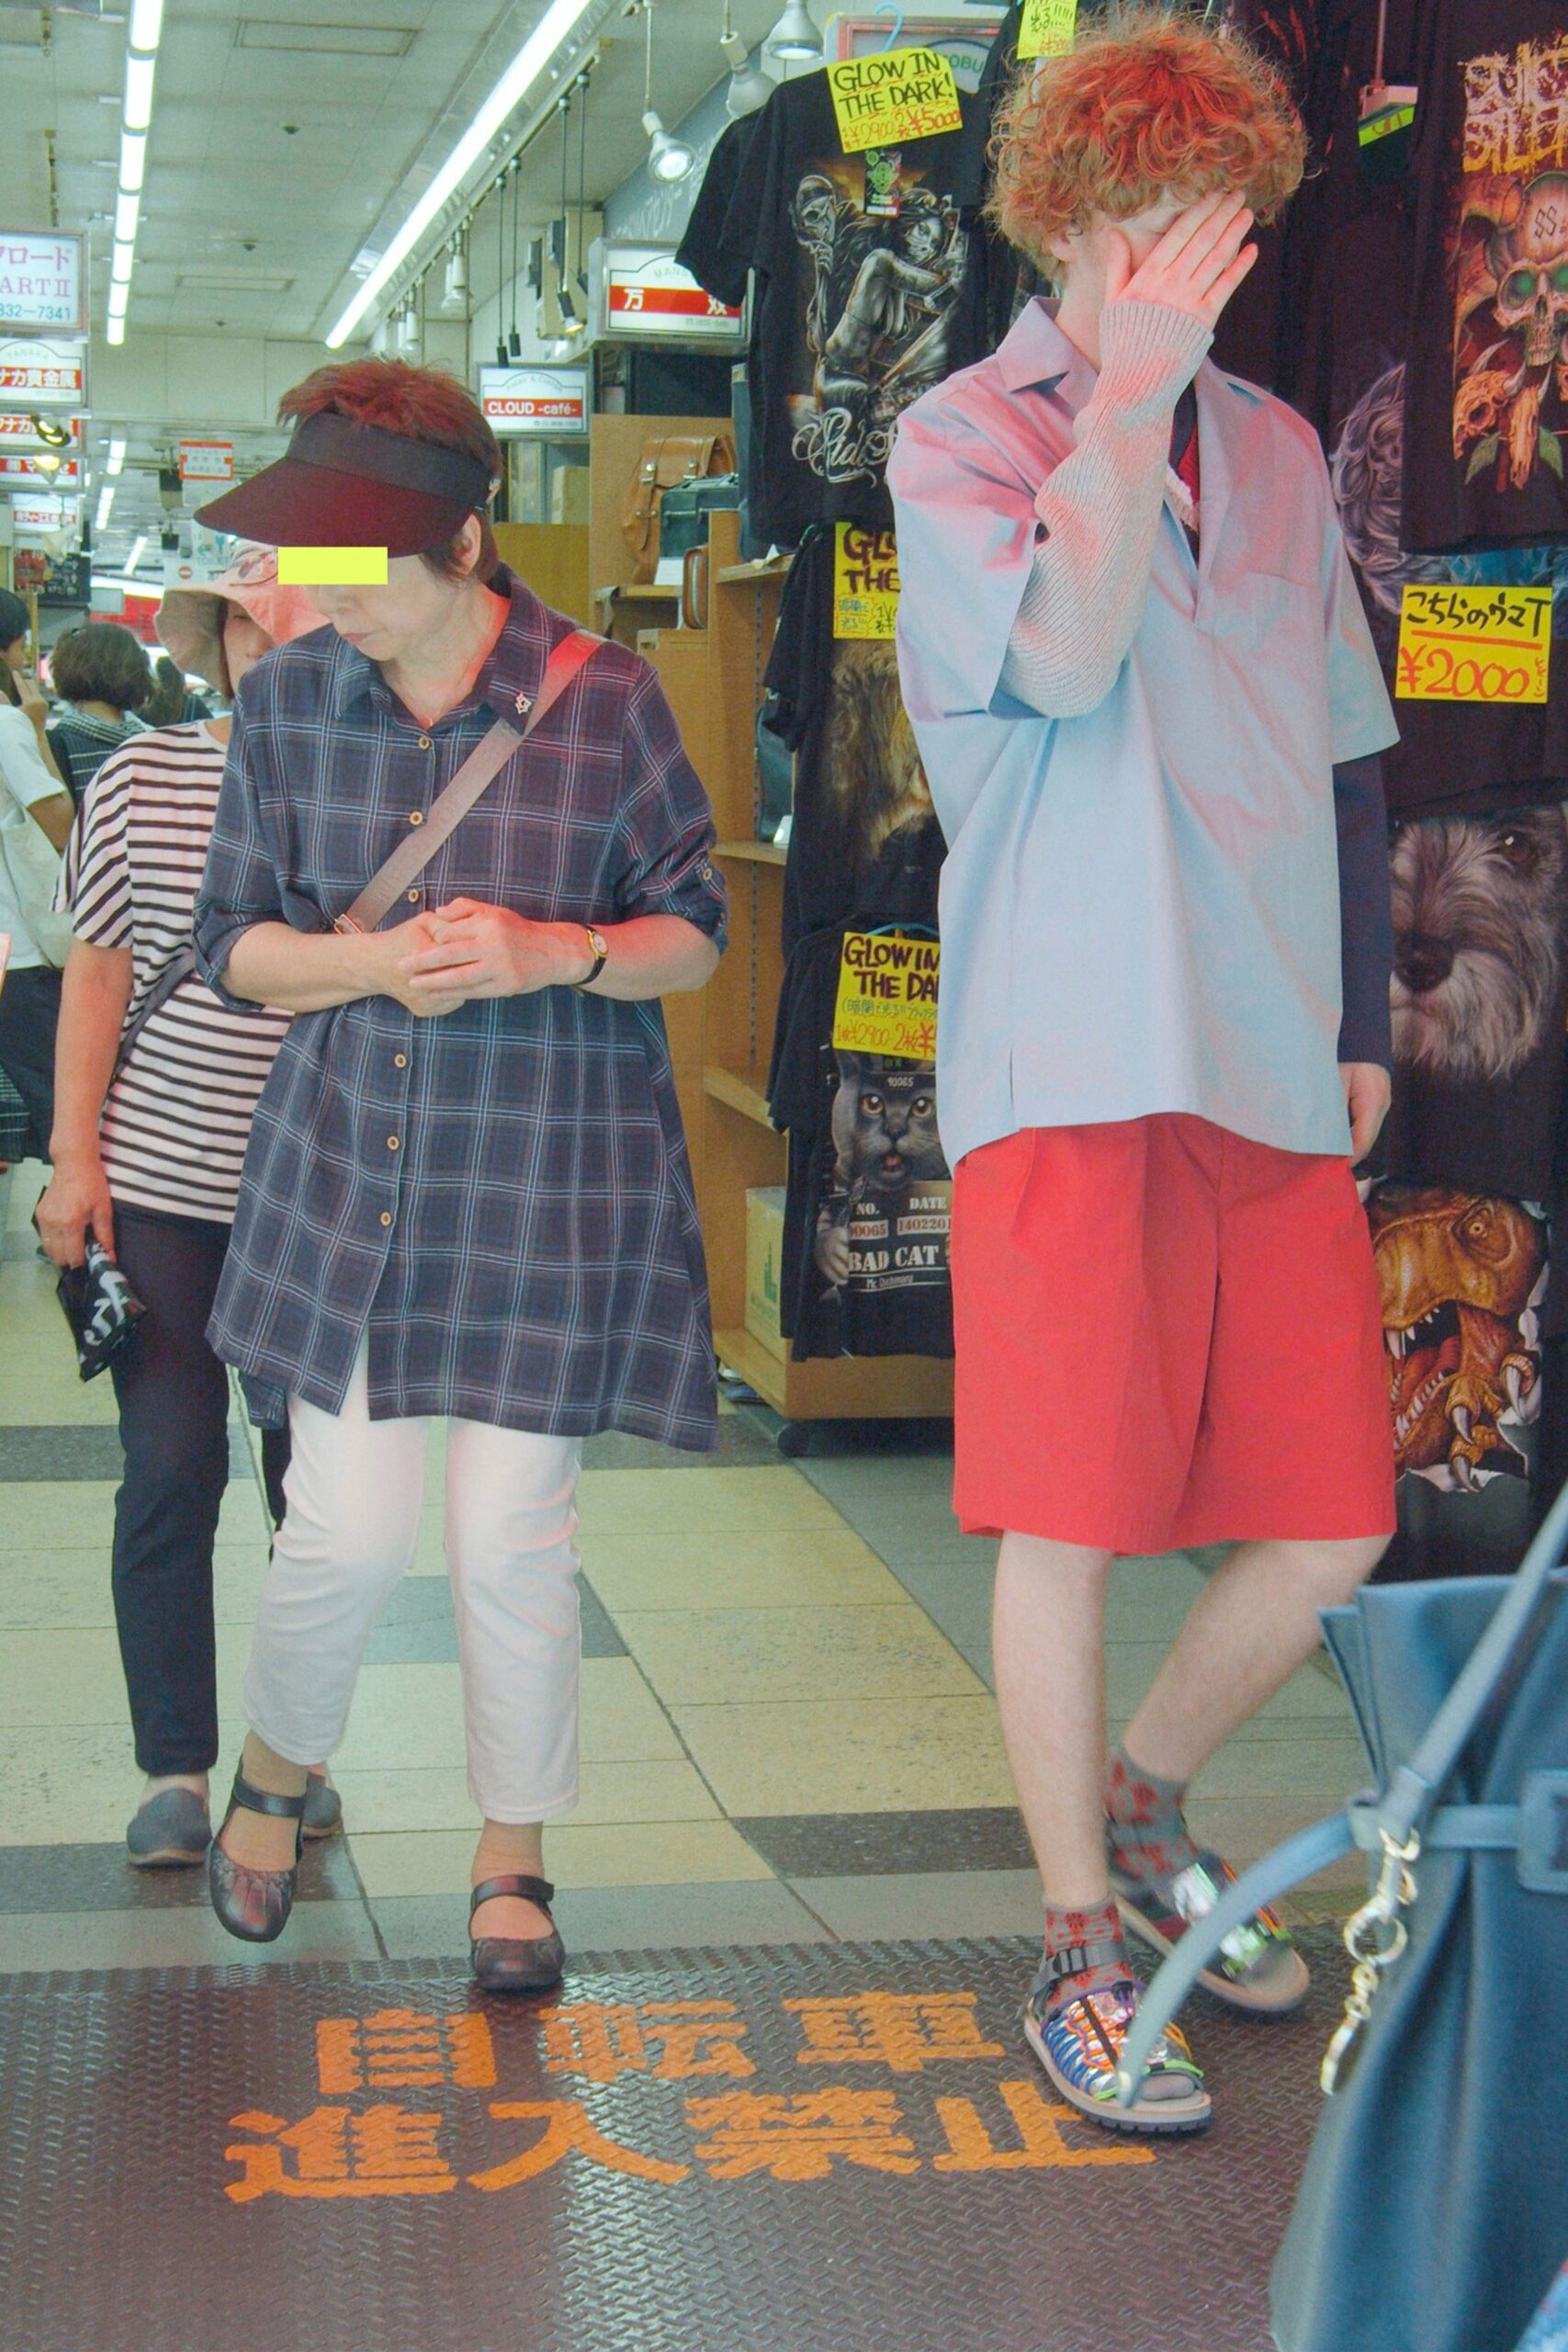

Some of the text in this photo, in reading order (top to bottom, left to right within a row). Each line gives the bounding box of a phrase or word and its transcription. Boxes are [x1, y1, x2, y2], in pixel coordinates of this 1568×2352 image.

[834, 51, 940, 91] GLOW IN
[947, 54, 983, 73] OBU
[838, 73, 953, 119] THE DARK!
[488, 401, 536, 414] CLOUD
[843, 569, 901, 594] THE
[1398, 644, 1530, 698] ¥2000
[844, 936, 913, 968] GLOW
[853, 971, 939, 1004] THE DA
[856, 1197, 947, 1216] NO. DATE
[849, 1246, 939, 1272] BAD CAT
[316, 1991, 1006, 2095] 自転車
[224, 2081, 1156, 2203] 進入禁止
